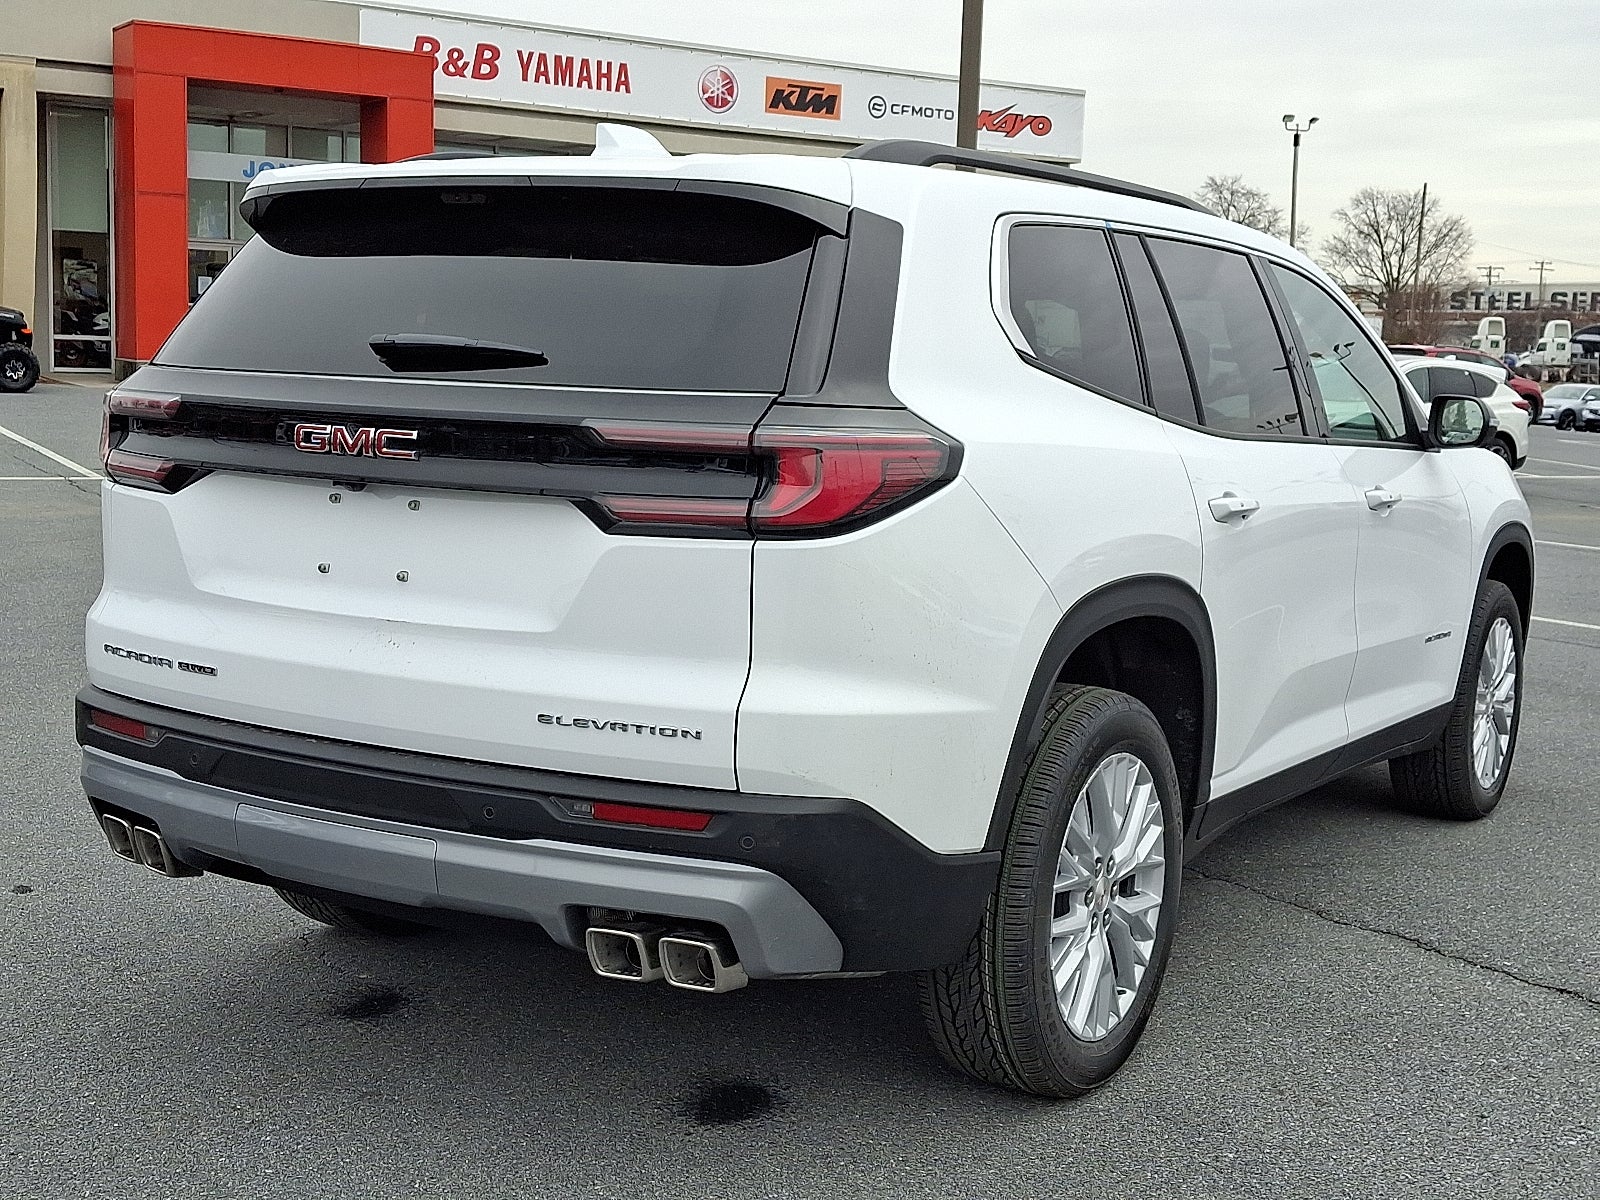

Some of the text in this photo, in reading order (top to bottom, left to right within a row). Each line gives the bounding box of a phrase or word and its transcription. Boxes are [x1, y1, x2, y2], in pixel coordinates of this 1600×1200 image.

[413, 35, 632, 94] B&B YAMAHA
[768, 83, 838, 115] KTM
[890, 103, 955, 120] CFMOTO
[1450, 291, 1540, 311] STEEL
[294, 423, 419, 460] GMC
[103, 643, 174, 669] ACADIA
[537, 712, 703, 741] ELEVATION
